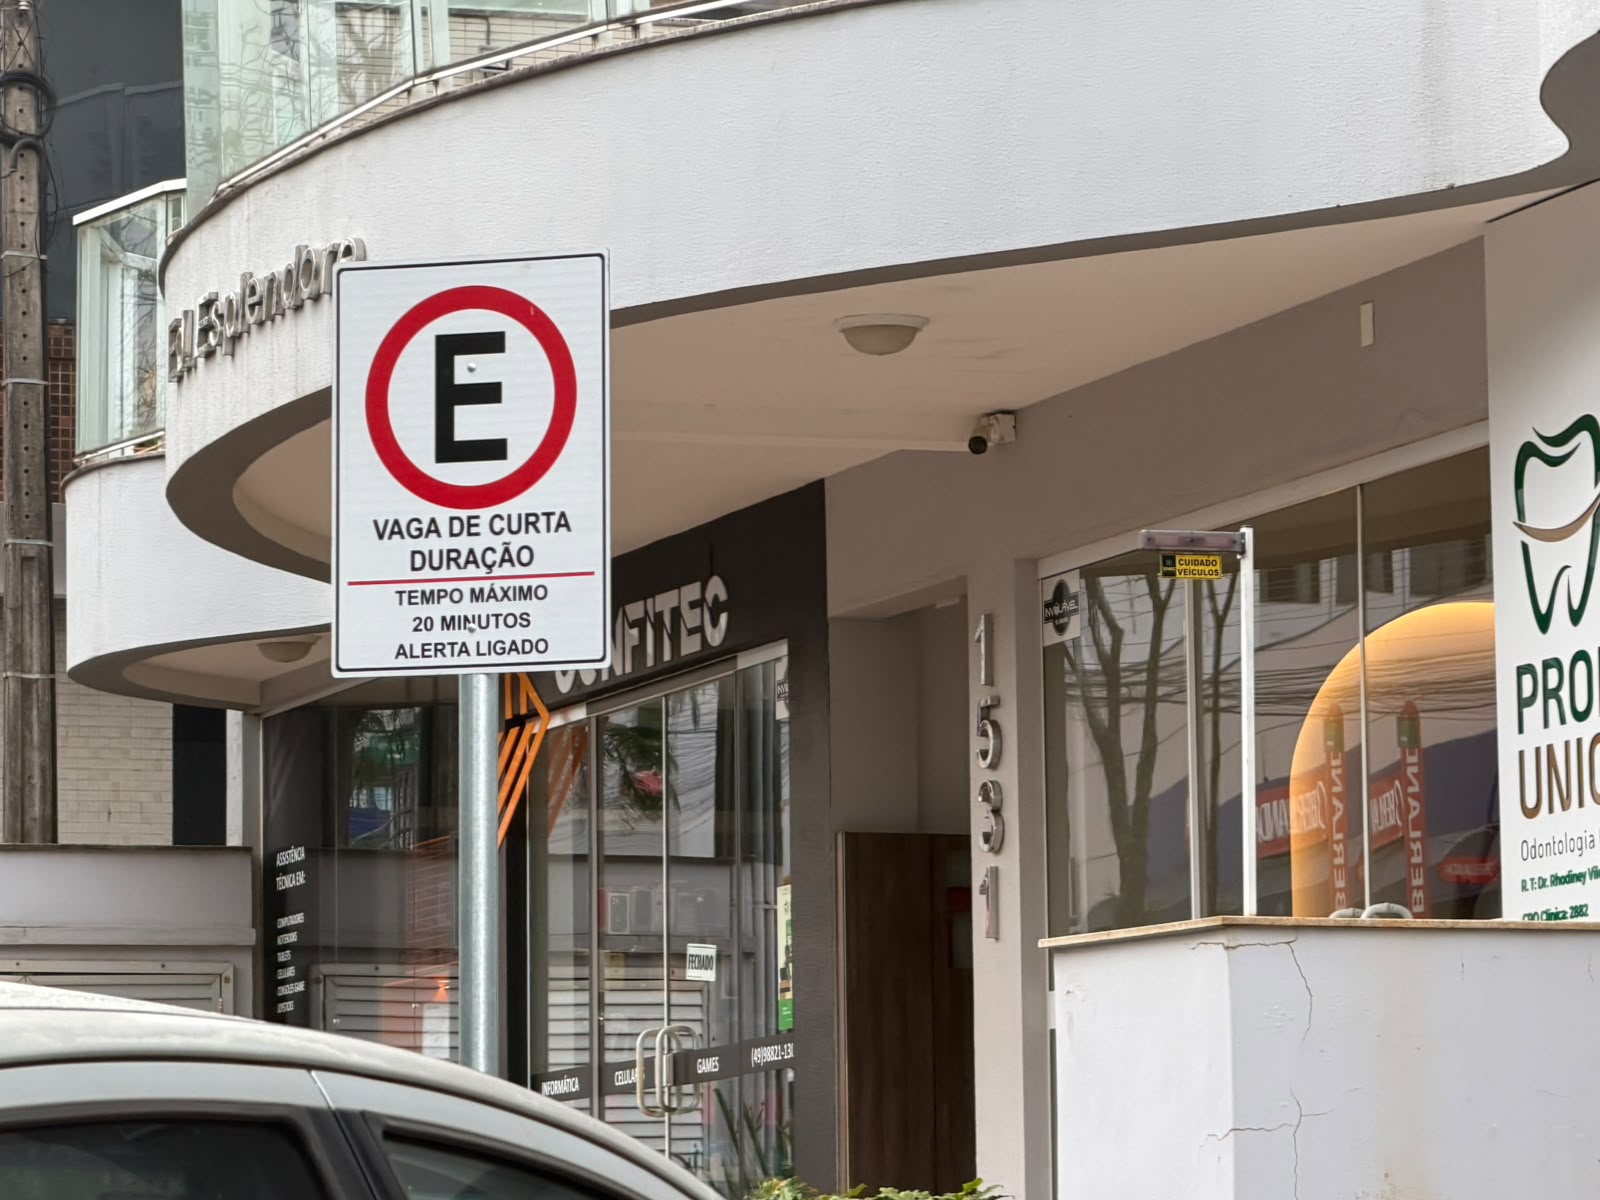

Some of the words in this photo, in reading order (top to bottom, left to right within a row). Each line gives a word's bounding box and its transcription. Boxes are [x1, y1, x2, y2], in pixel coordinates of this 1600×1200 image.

[435, 331, 507, 464] E
[373, 517, 442, 540] VAGA
[449, 515, 481, 537] DE
[488, 511, 572, 536] CURTA
[410, 541, 535, 574] DURAÇÃO
[1178, 558, 1217, 567] CUIDADO
[1178, 567, 1219, 576] VEÍCULOS
[395, 588, 464, 606] TEMPO
[470, 583, 548, 603] MÁXIMO
[412, 616, 434, 632] 20
[440, 612, 531, 631] MINUTOS
[555, 575, 728, 694] NFITEC
[394, 641, 471, 659] ALERTA
[476, 638, 549, 656] LIGADO
[1516, 648, 1600, 735] PRO
[975, 614, 1004, 941] 1531
[1521, 829, 1595, 861] Odontologia
[1538, 876, 1549, 890] Dr.
[688, 953, 713, 971] FECHADO
[541, 1075, 579, 1096] INFORMÁTICA
[697, 1057, 719, 1073] GAMES
